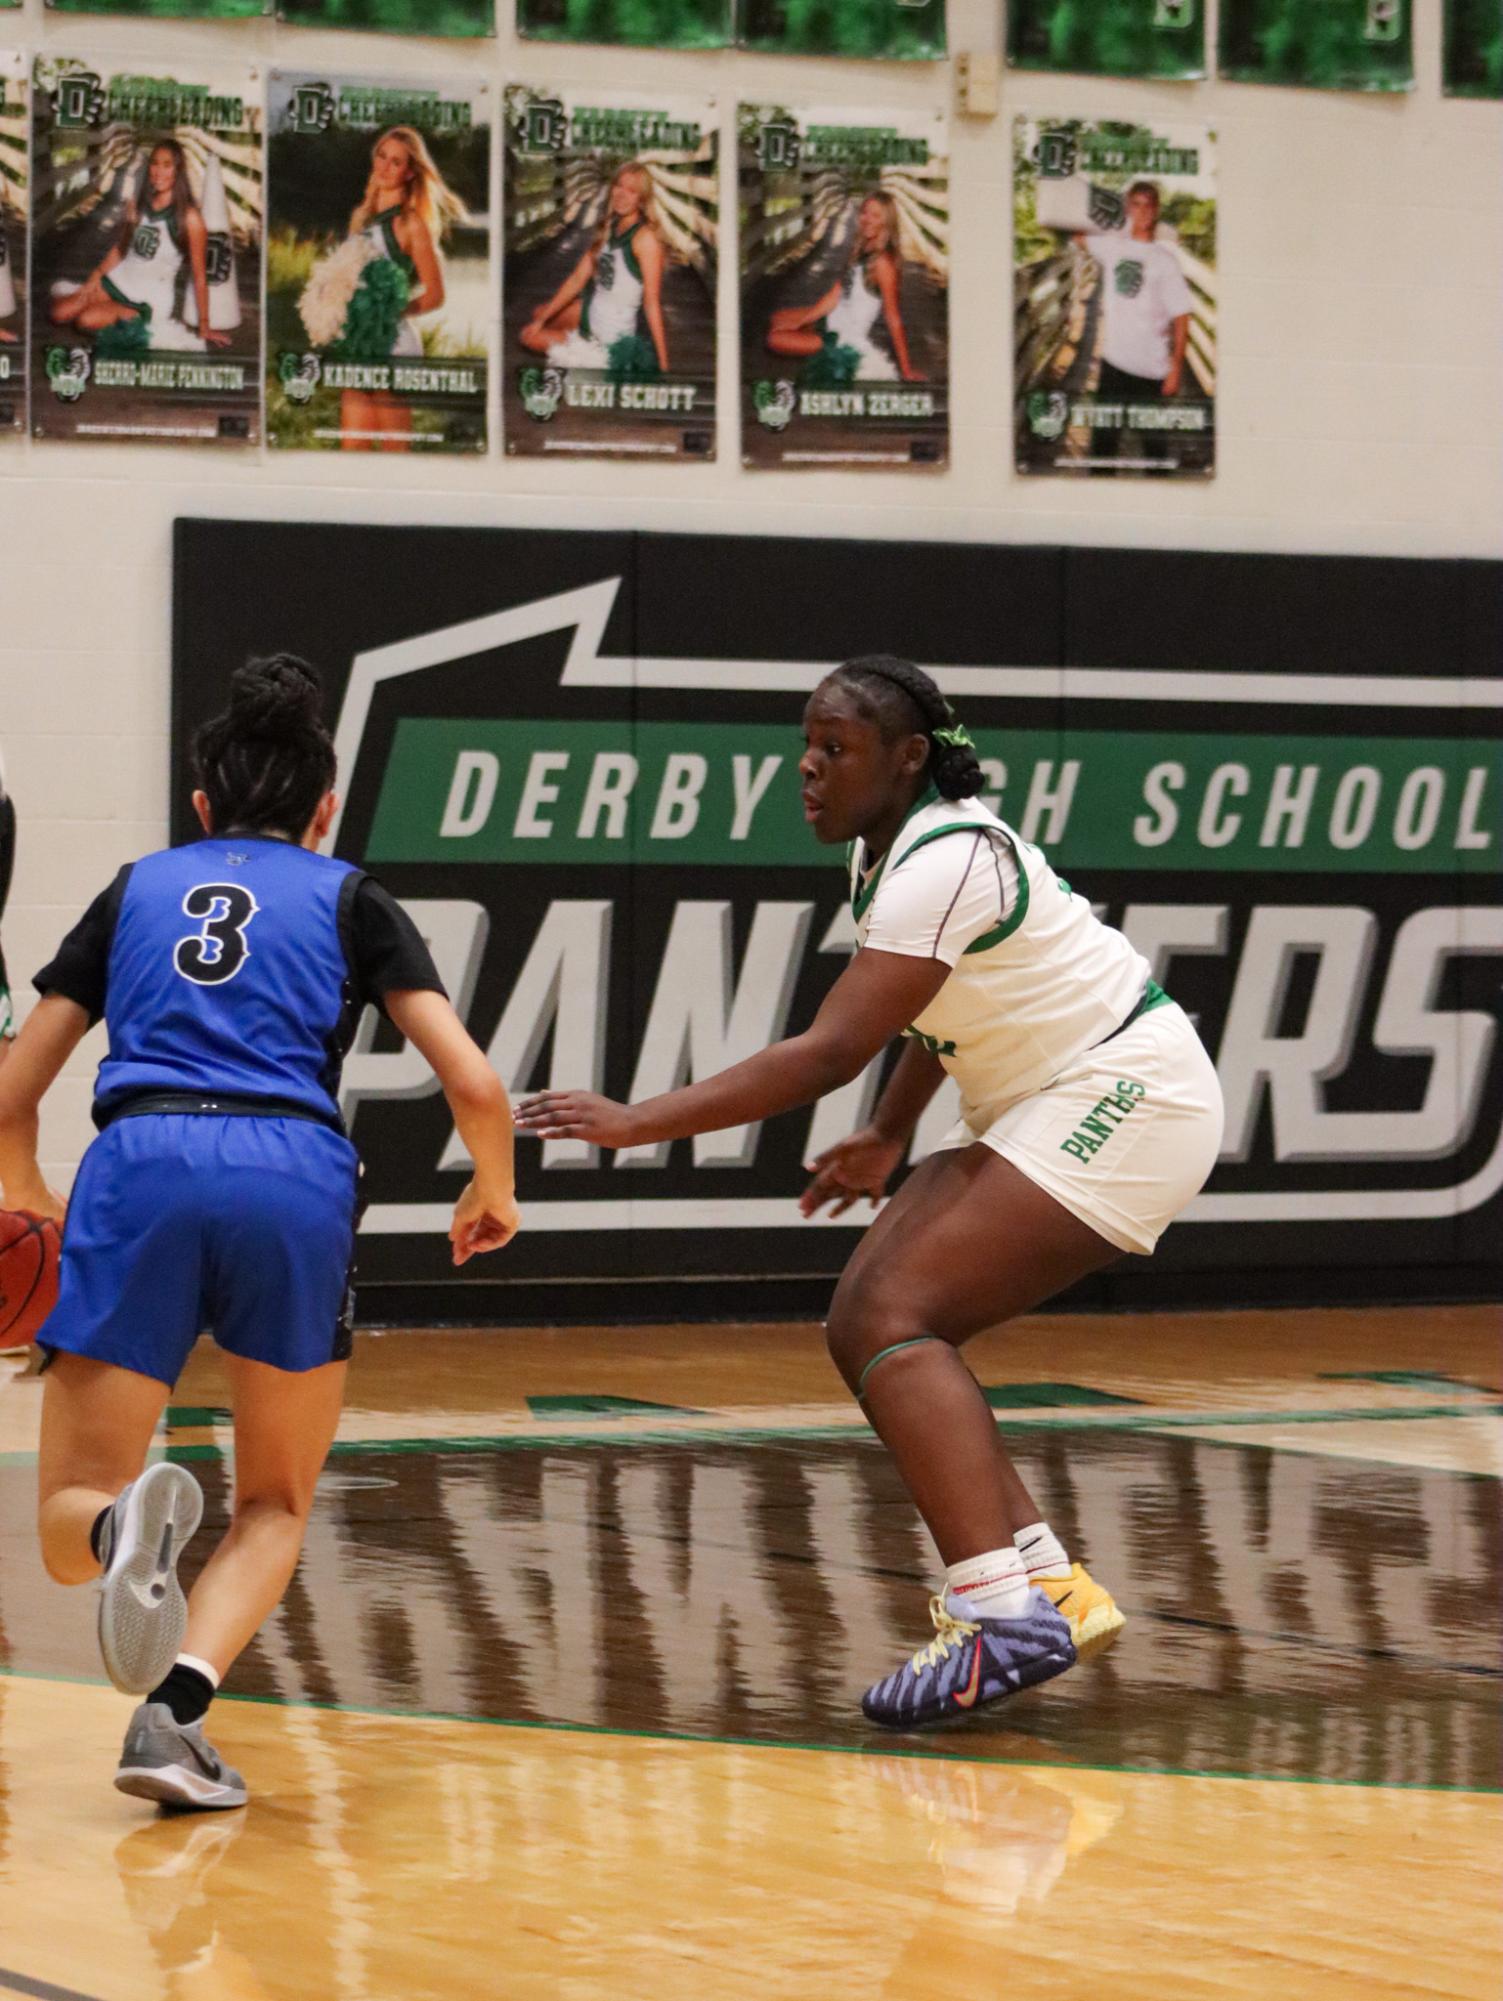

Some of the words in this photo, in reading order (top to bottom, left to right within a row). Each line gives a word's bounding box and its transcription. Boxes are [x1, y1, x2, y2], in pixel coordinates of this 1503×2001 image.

[323, 365, 389, 389] KADENCE
[393, 368, 478, 393] ROSENTHAL
[568, 384, 615, 408] LEXI
[620, 385, 696, 411] SCHOTT
[801, 392, 864, 416] ASHLYN
[439, 750, 783, 841] DERBY
[1133, 760, 1493, 850] SCHOOL
[173, 882, 260, 986] 3
